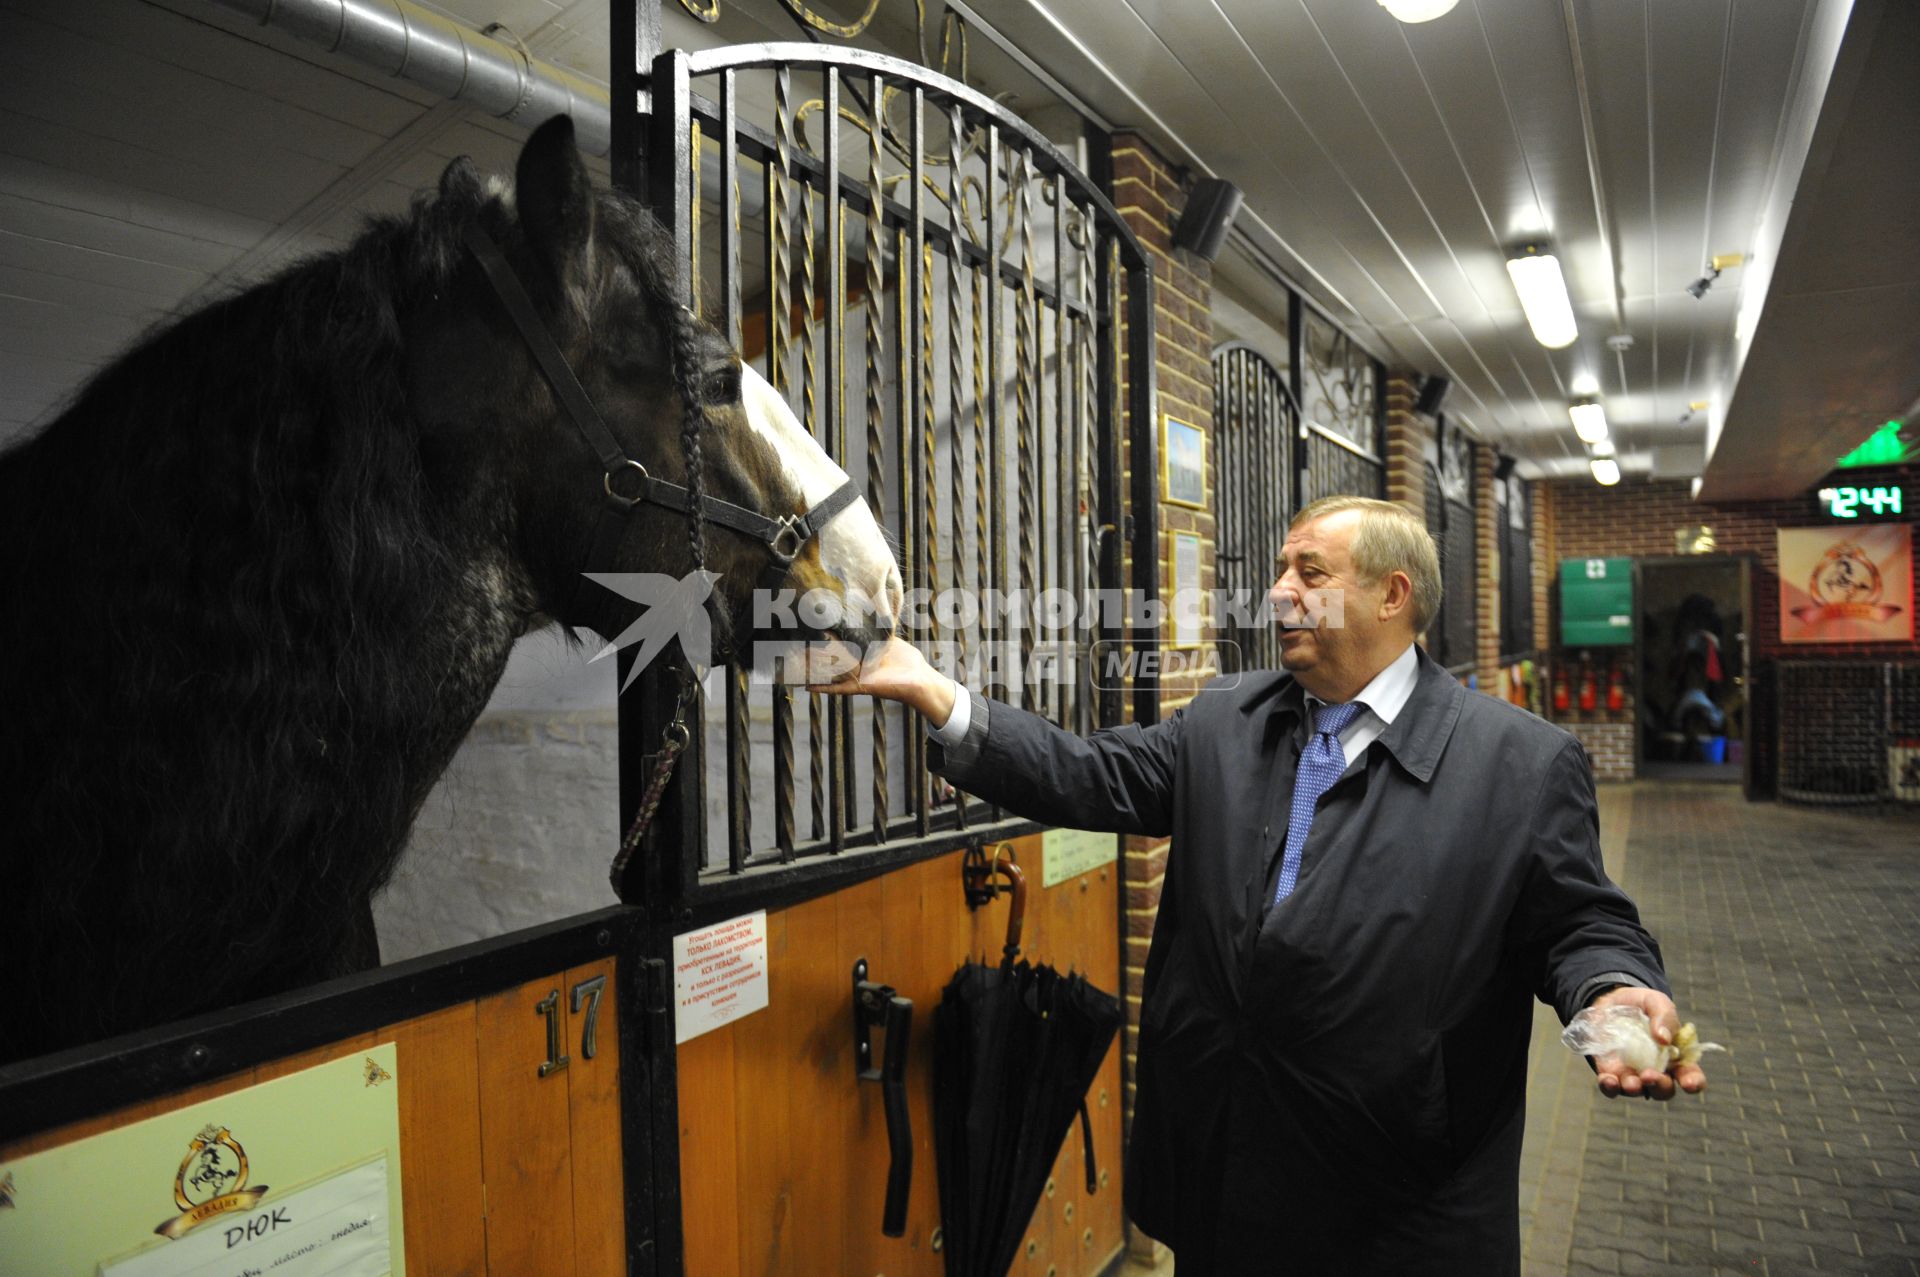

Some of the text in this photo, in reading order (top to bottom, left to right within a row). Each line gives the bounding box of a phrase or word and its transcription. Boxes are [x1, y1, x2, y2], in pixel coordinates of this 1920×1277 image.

[687, 942, 712, 957] ТОЛЬКО
[701, 967, 713, 976] КСК
[536, 974, 607, 1078] 17
